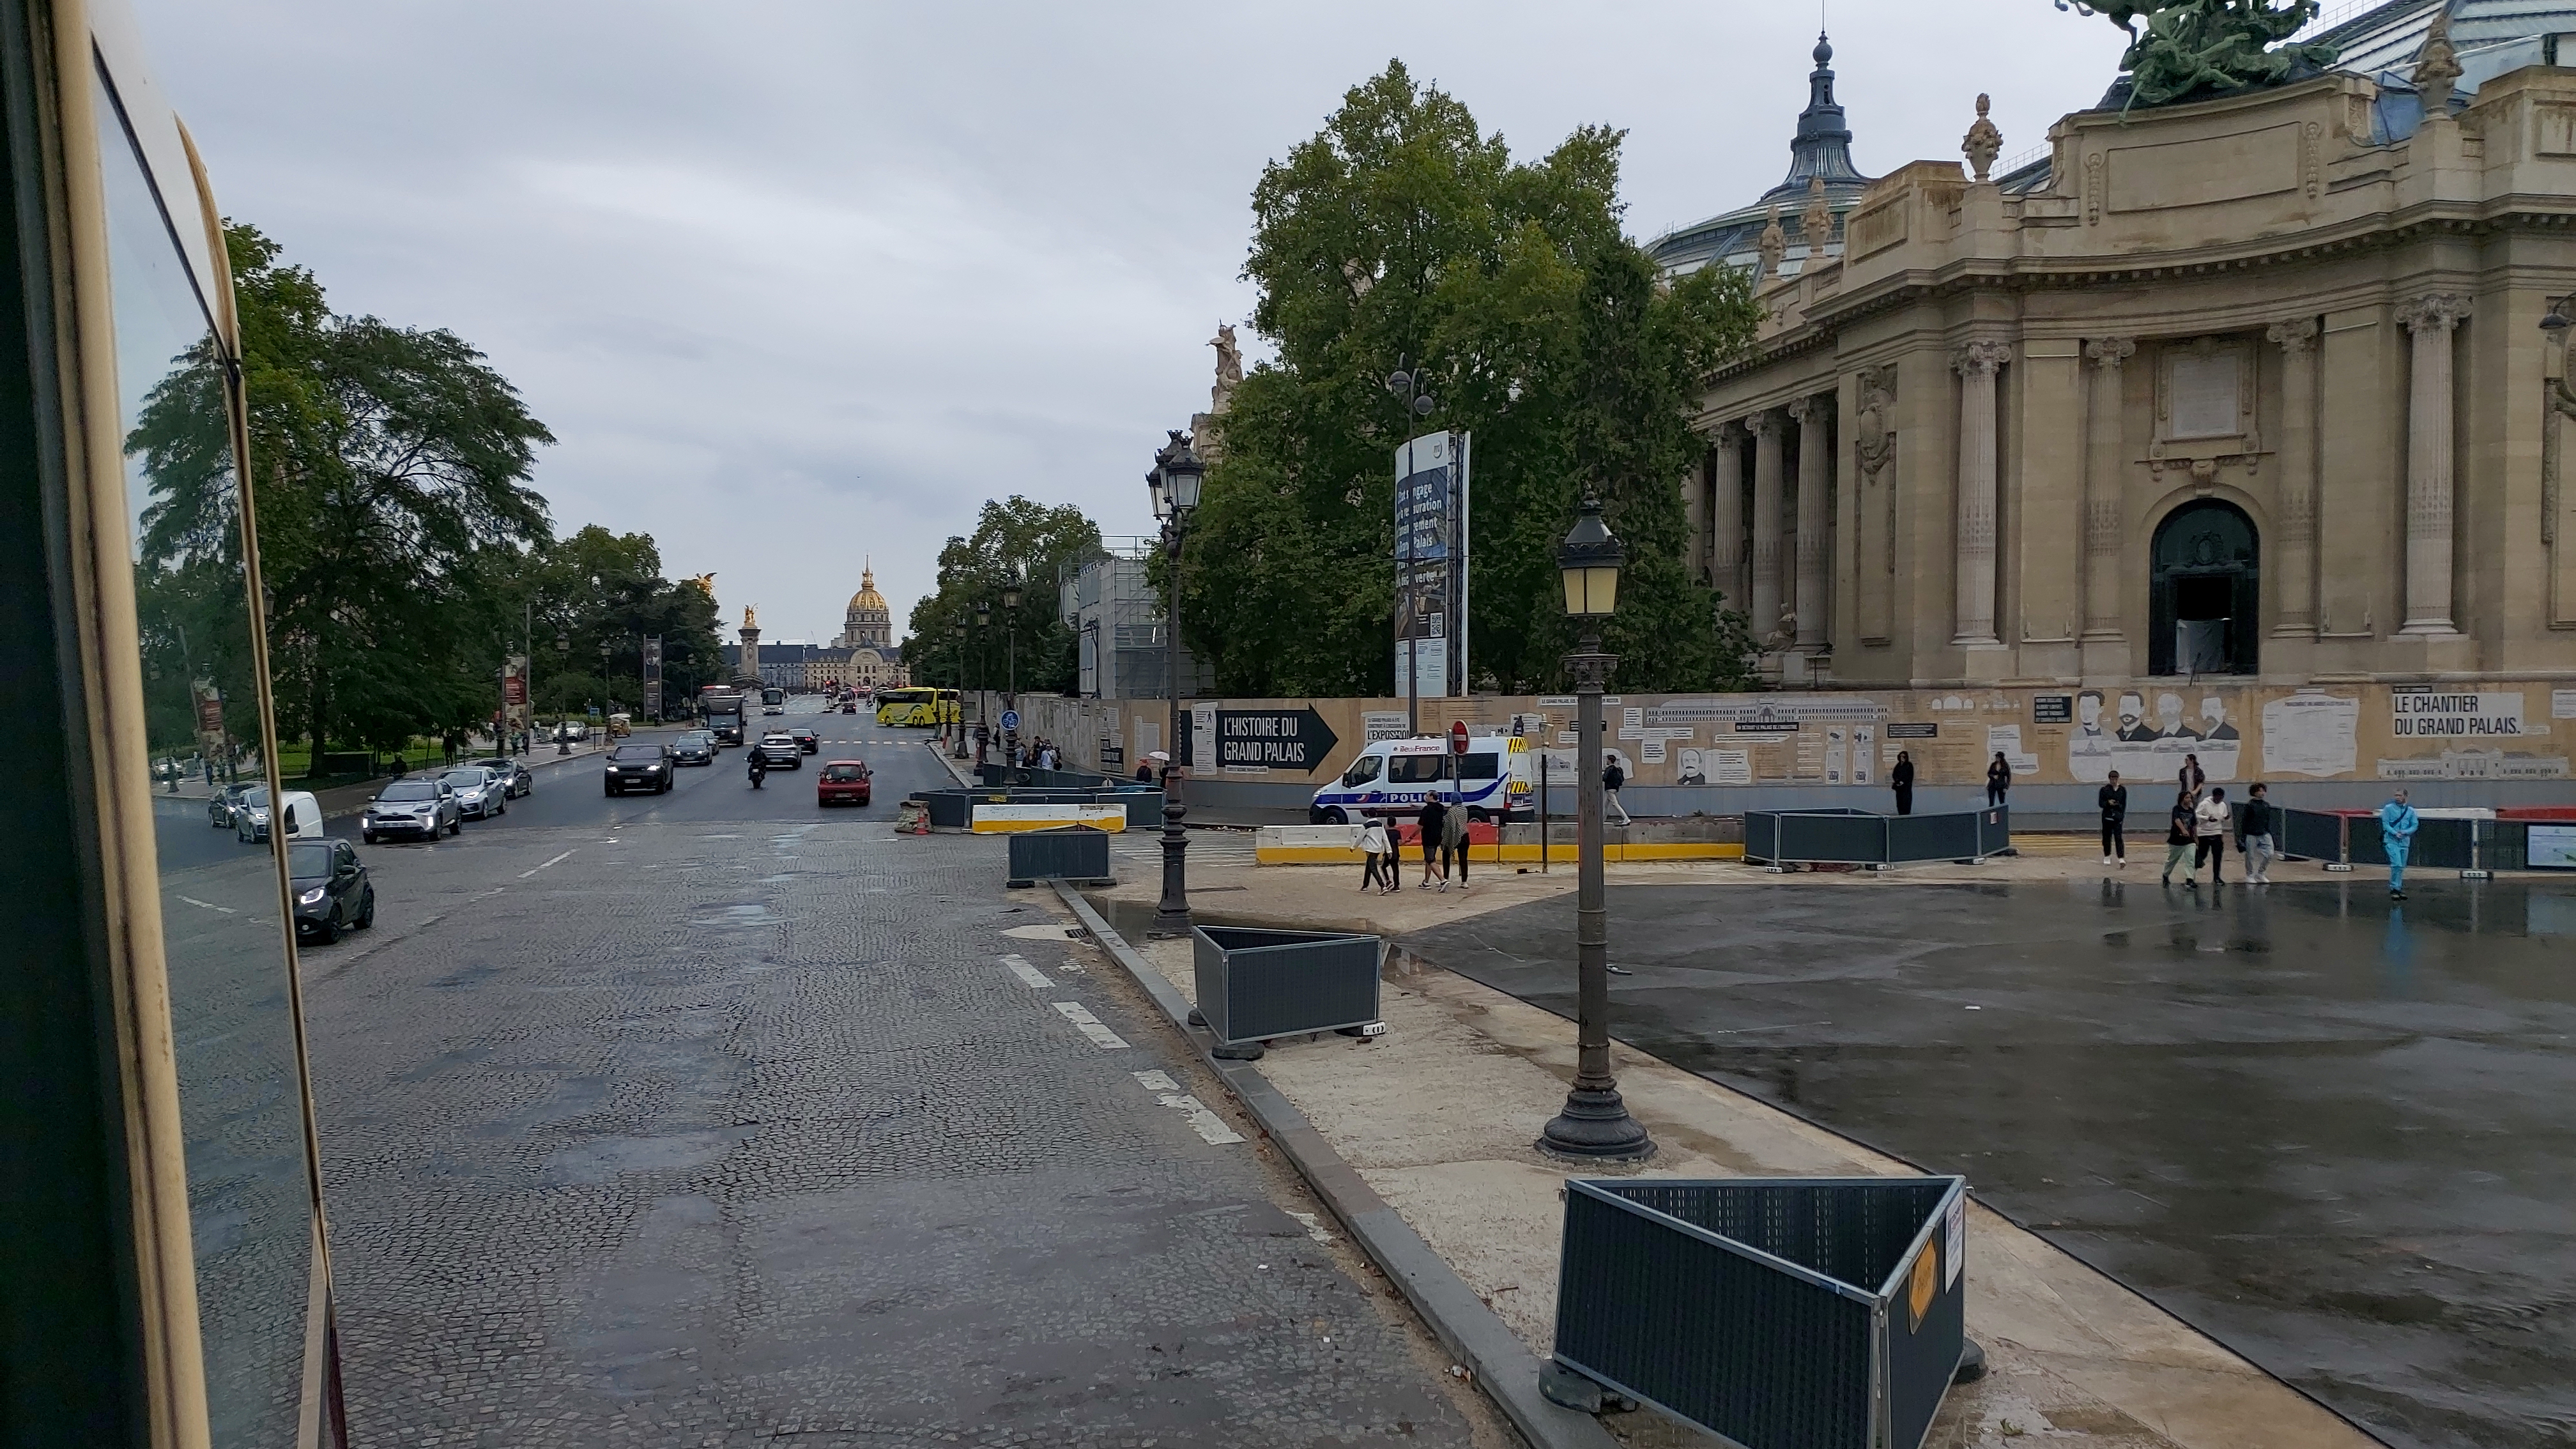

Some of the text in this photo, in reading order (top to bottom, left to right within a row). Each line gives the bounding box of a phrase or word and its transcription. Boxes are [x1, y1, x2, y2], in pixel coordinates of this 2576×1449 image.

[2395, 695, 2479, 713] LE CHANTIER
[1224, 717, 1298, 737] L'HISTOIRE DU
[2395, 717, 2521, 735] DU GRAND PALAIS.
[1224, 741, 1305, 762] GRAND PALAIS
[1390, 793, 1439, 802] POLI
